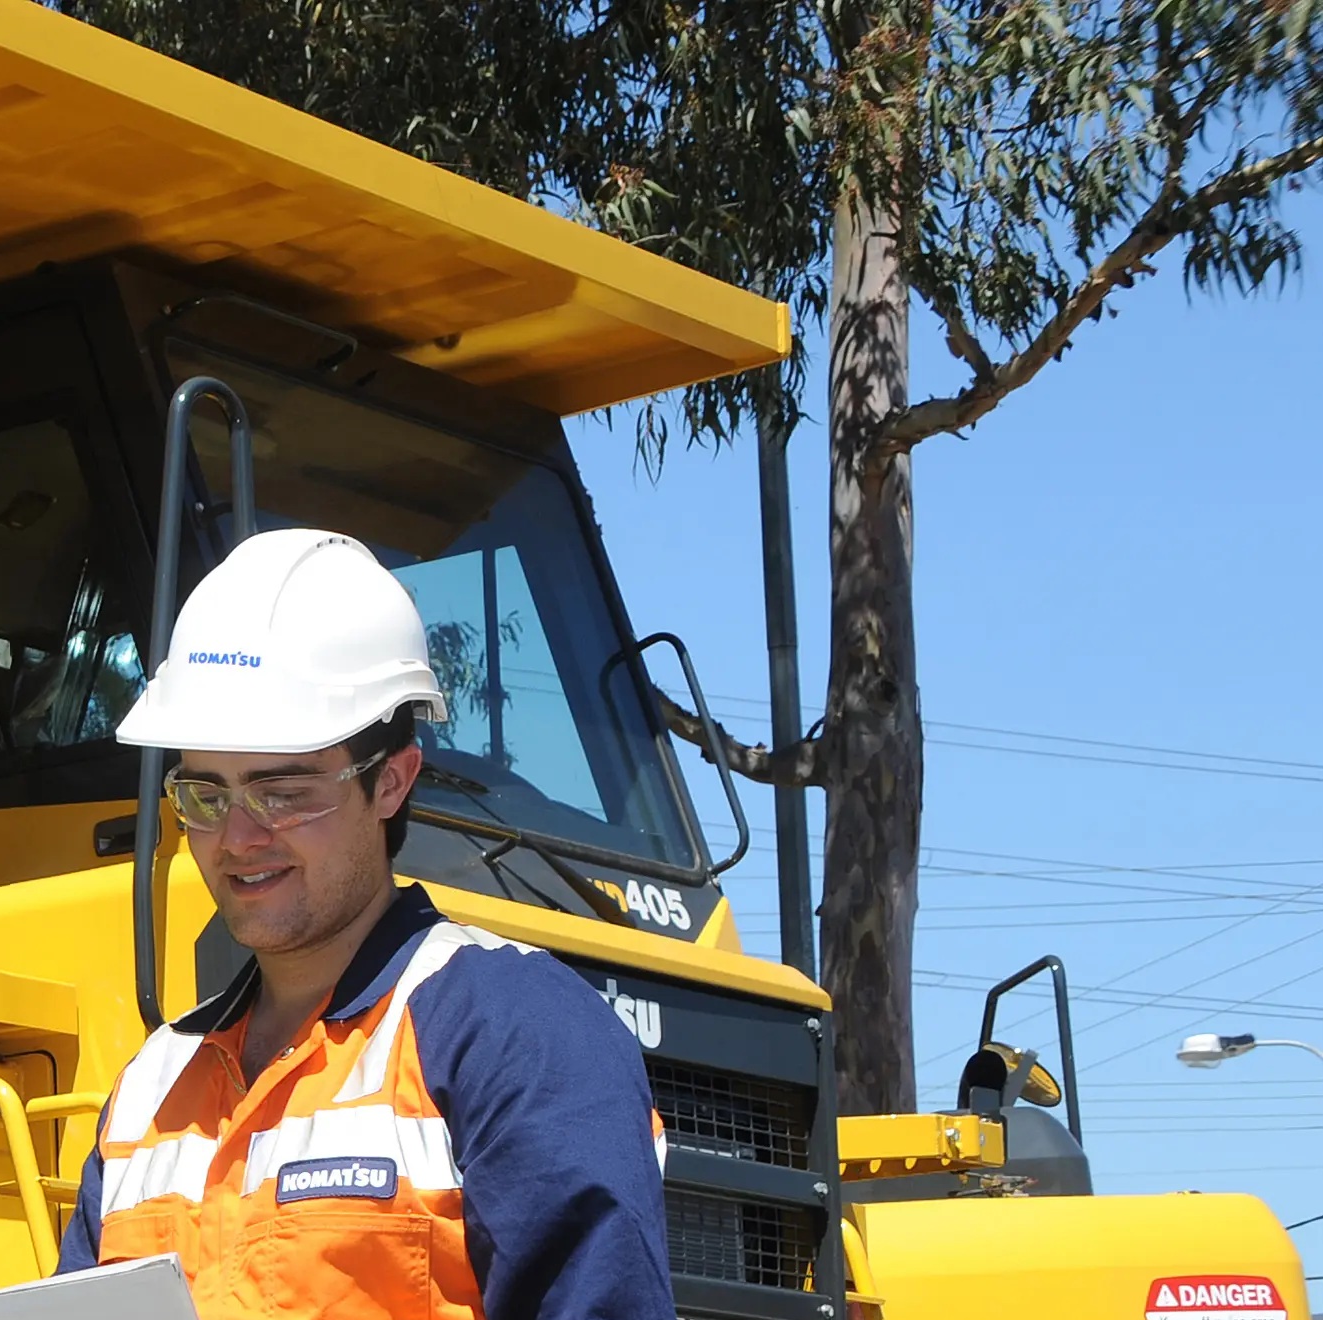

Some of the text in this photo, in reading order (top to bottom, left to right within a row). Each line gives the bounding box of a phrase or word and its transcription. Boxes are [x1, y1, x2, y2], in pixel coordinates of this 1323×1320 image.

[188, 651, 261, 668] KOMATSU
[281, 1162, 388, 1192] KOMATSU
[1178, 1283, 1274, 1307] DANGER
